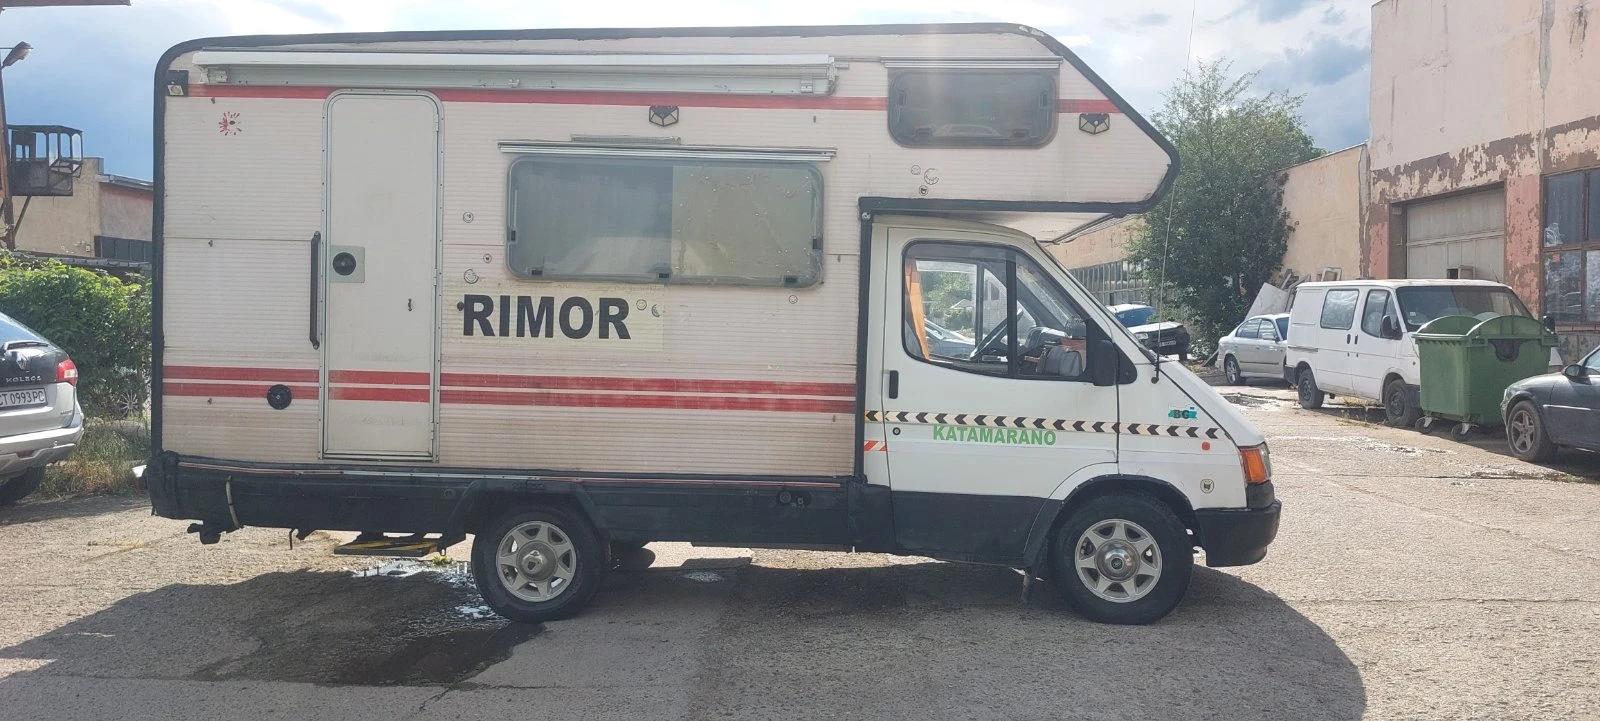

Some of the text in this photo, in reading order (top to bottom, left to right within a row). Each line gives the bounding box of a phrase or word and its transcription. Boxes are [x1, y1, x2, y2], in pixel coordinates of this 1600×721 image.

[463, 294, 631, 340] RIMOR
[10, 391, 32, 404] 0993
[1173, 409, 1190, 419] BG
[933, 424, 1057, 446] KATAMARANO
